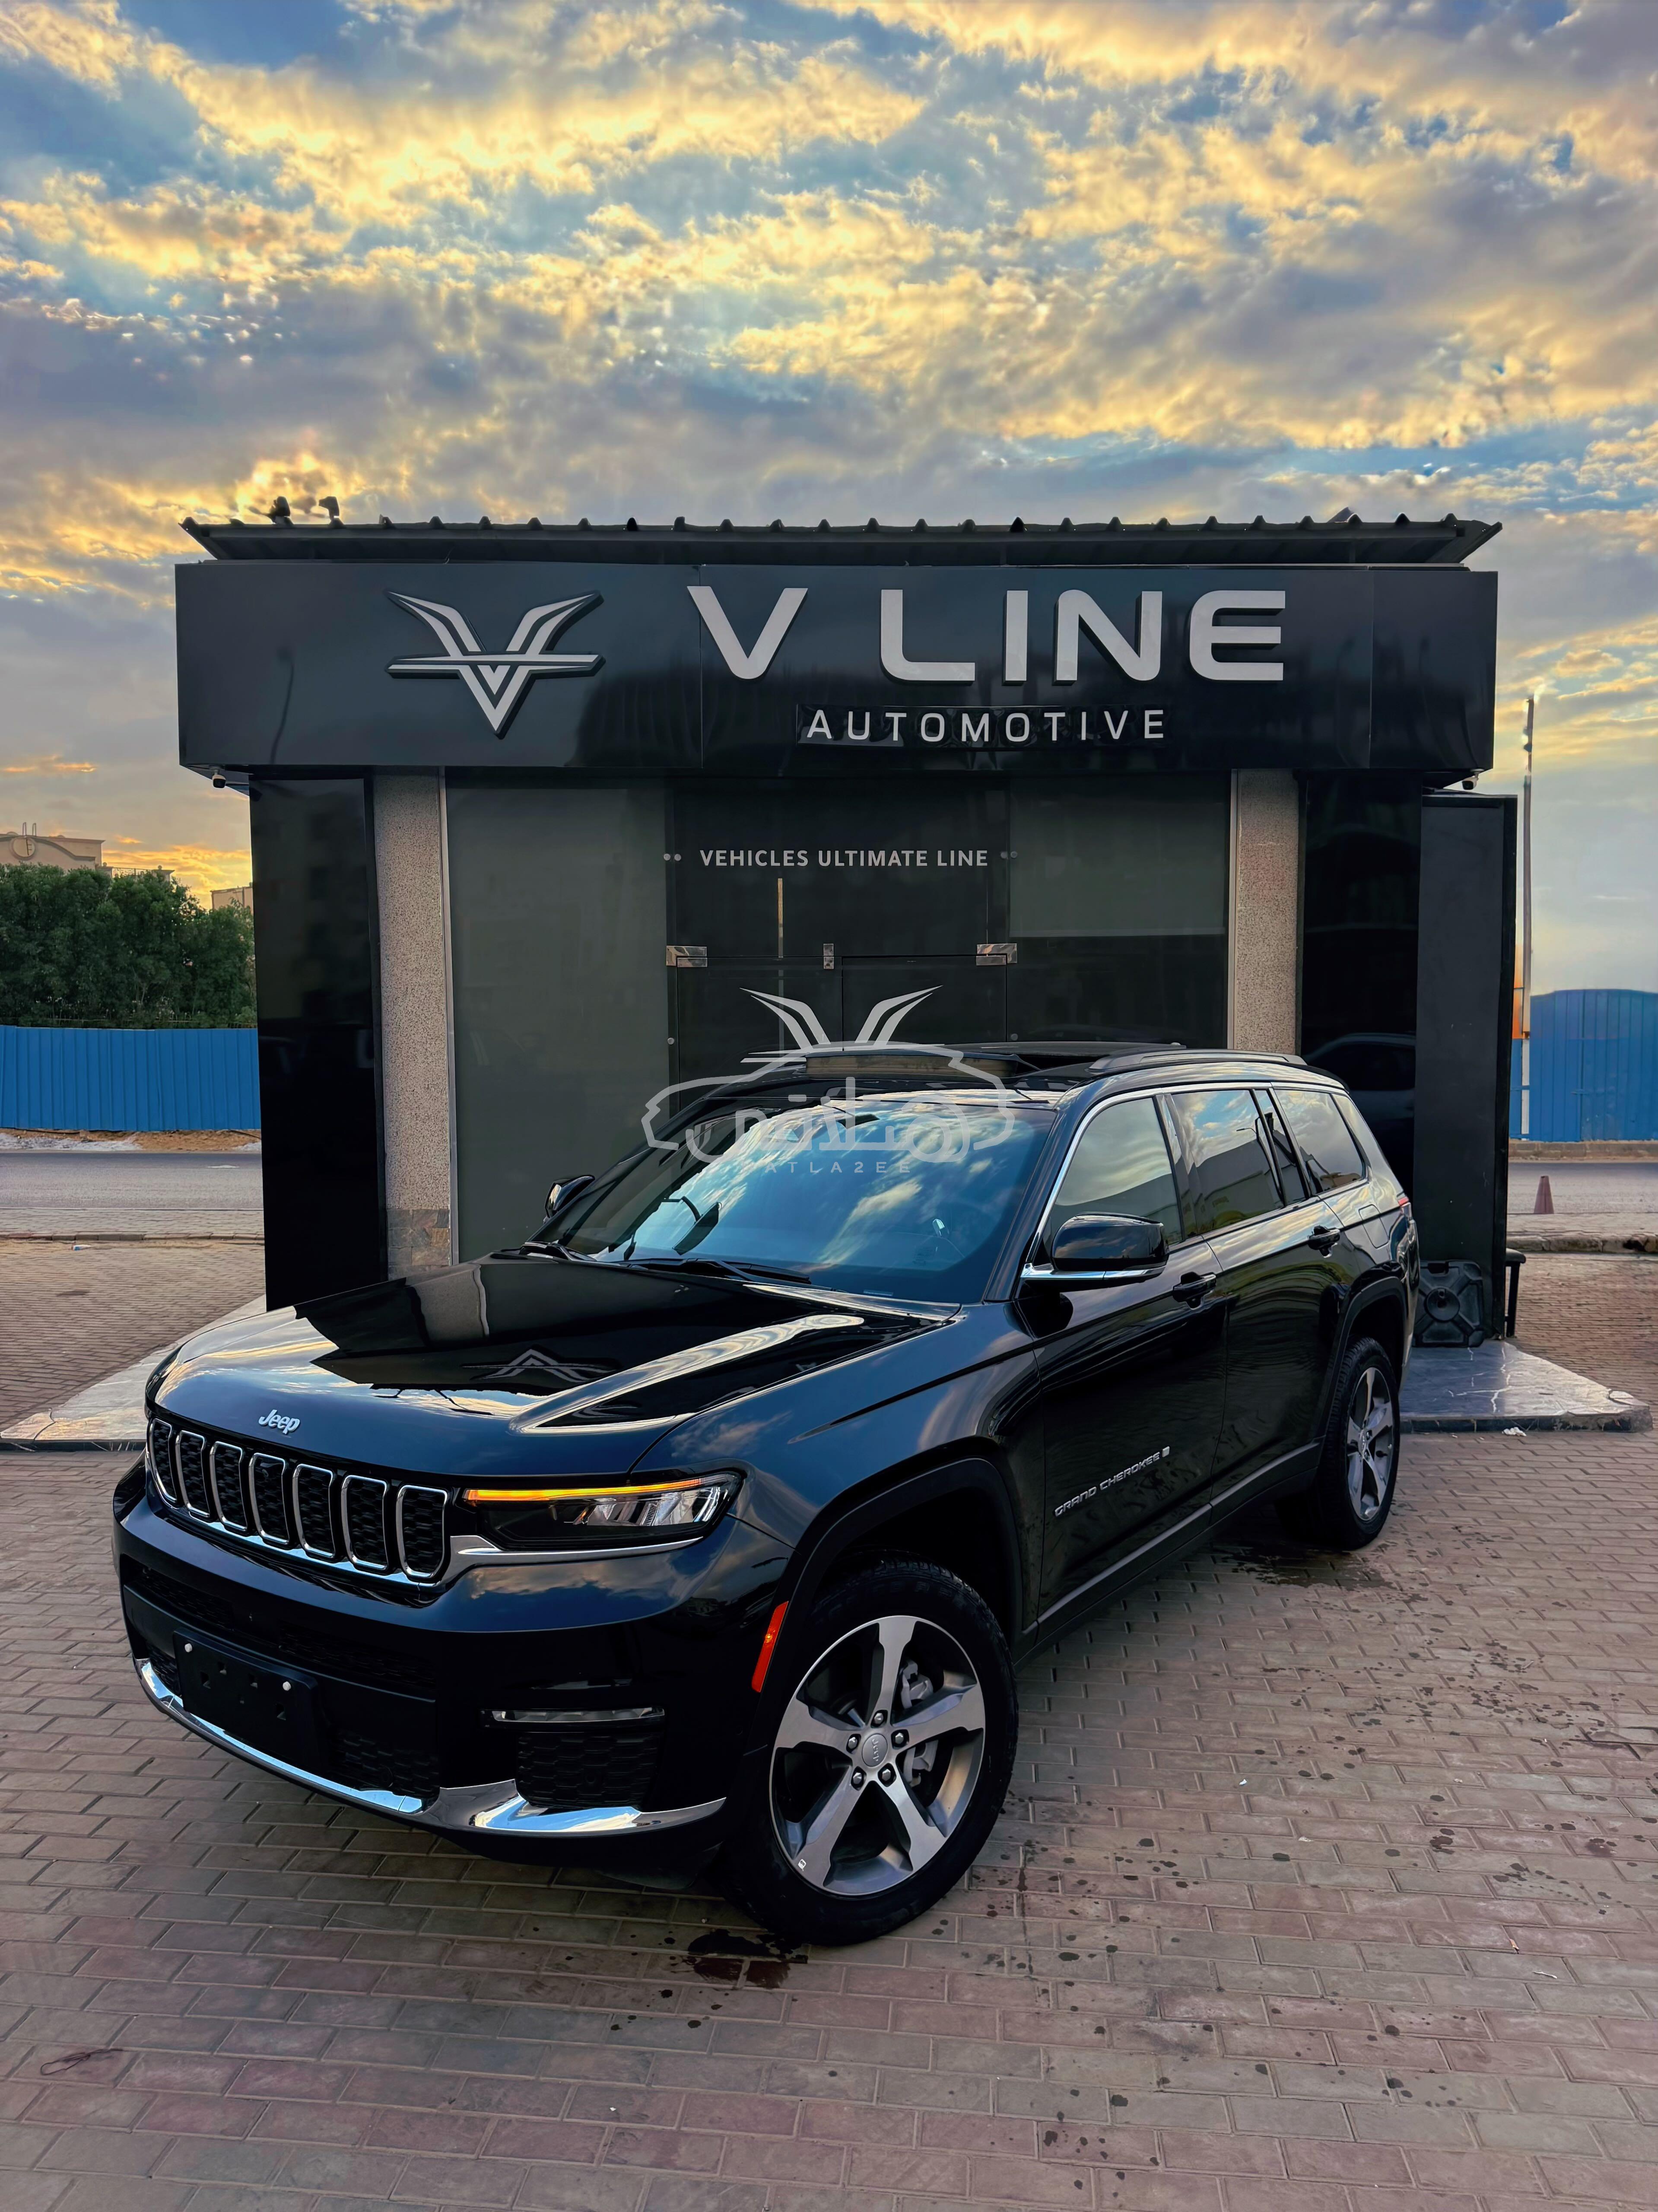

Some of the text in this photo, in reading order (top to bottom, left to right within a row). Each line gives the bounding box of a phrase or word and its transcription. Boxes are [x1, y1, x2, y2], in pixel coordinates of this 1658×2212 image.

[687, 586, 1286, 682] V LINE
[807, 710, 1165, 742] AUTOMOTIVE
[700, 850, 988, 867] VEHICLES ULTIMATE LINE
[258, 1409, 300, 1435] Jeep
[1054, 1452, 1160, 1517] GRAND CHEROKEE
